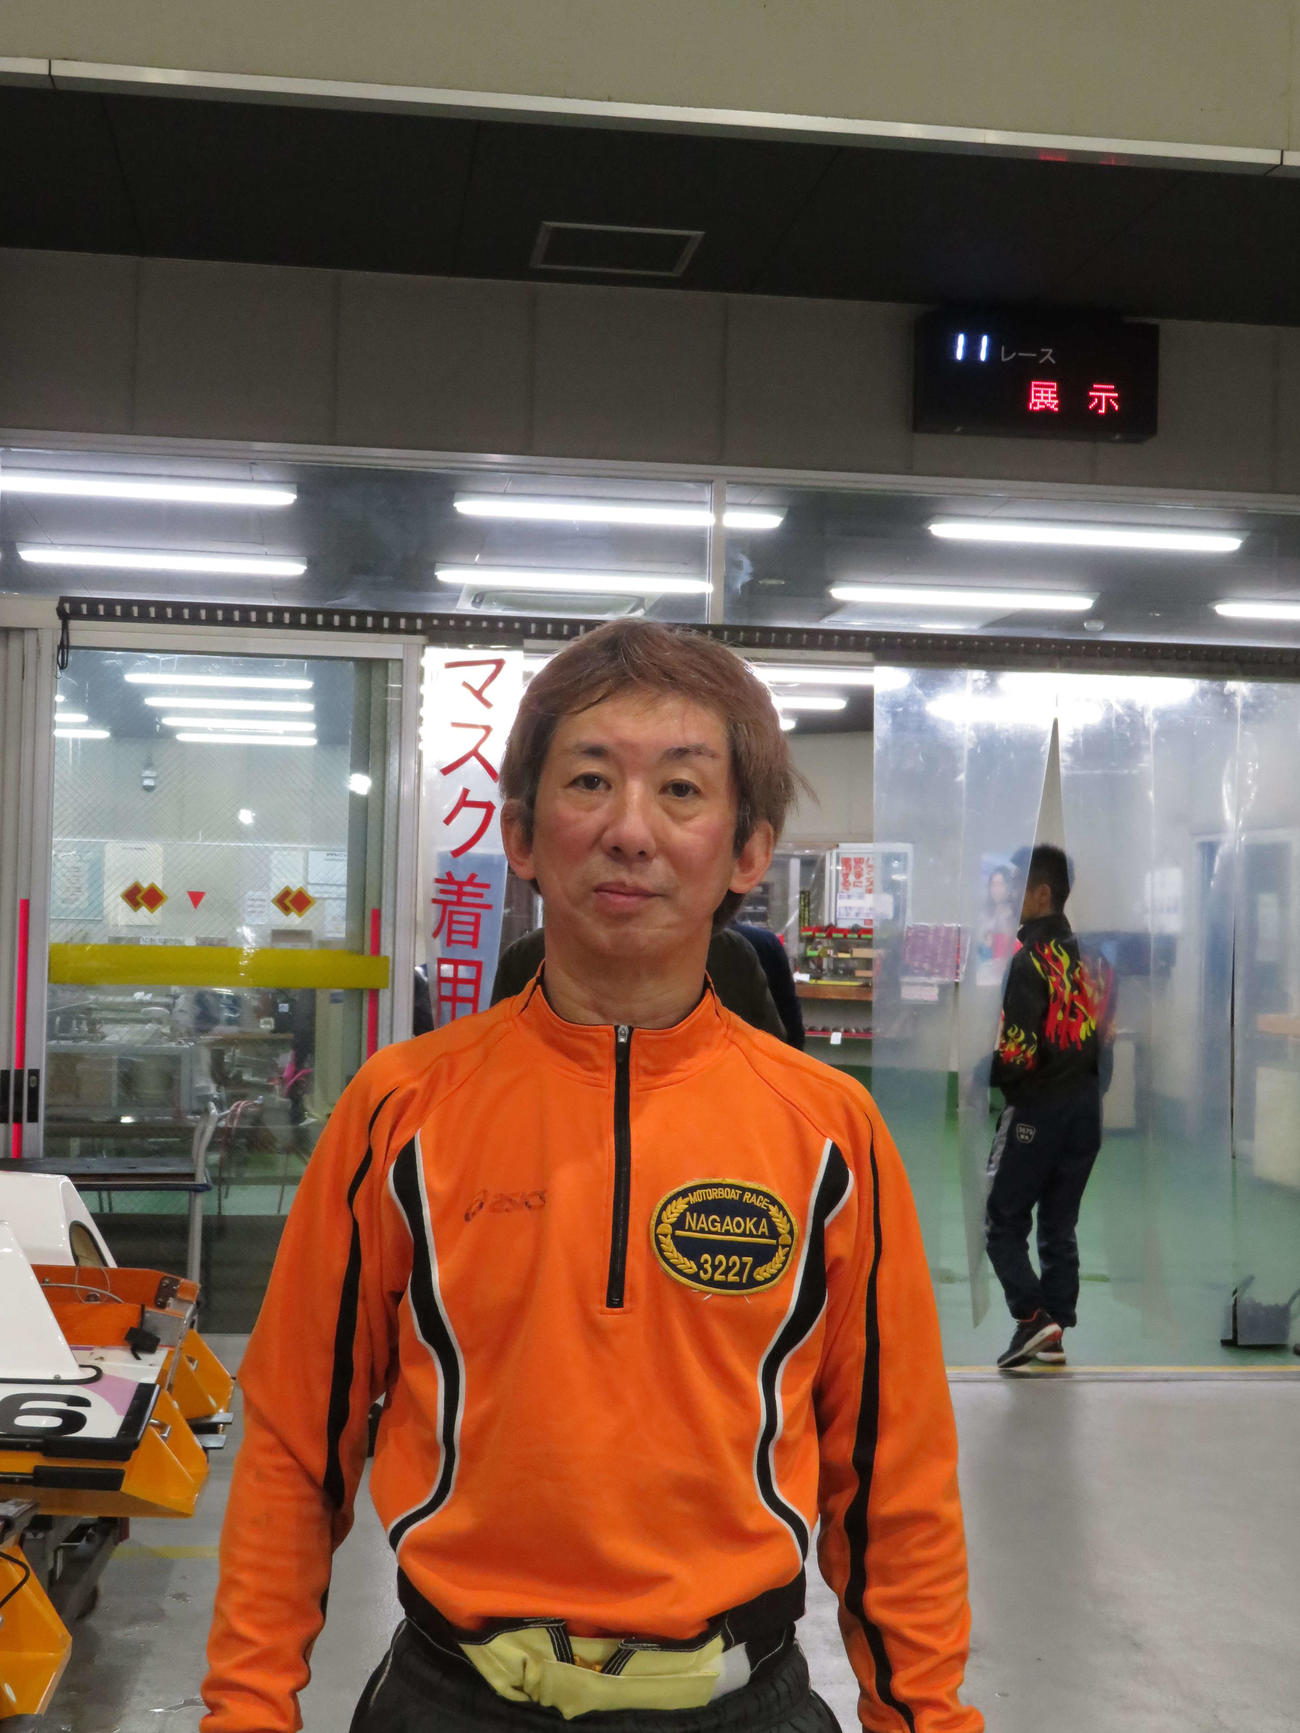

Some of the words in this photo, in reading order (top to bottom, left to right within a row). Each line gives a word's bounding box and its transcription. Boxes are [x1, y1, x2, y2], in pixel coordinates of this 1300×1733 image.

[688, 1187, 742, 1205] MOTORBOAT
[742, 1191, 770, 1210] RACE
[685, 1212, 769, 1236] NAGAOKA
[699, 1253, 753, 1284] 3227
[0, 1392, 92, 1436] 6
